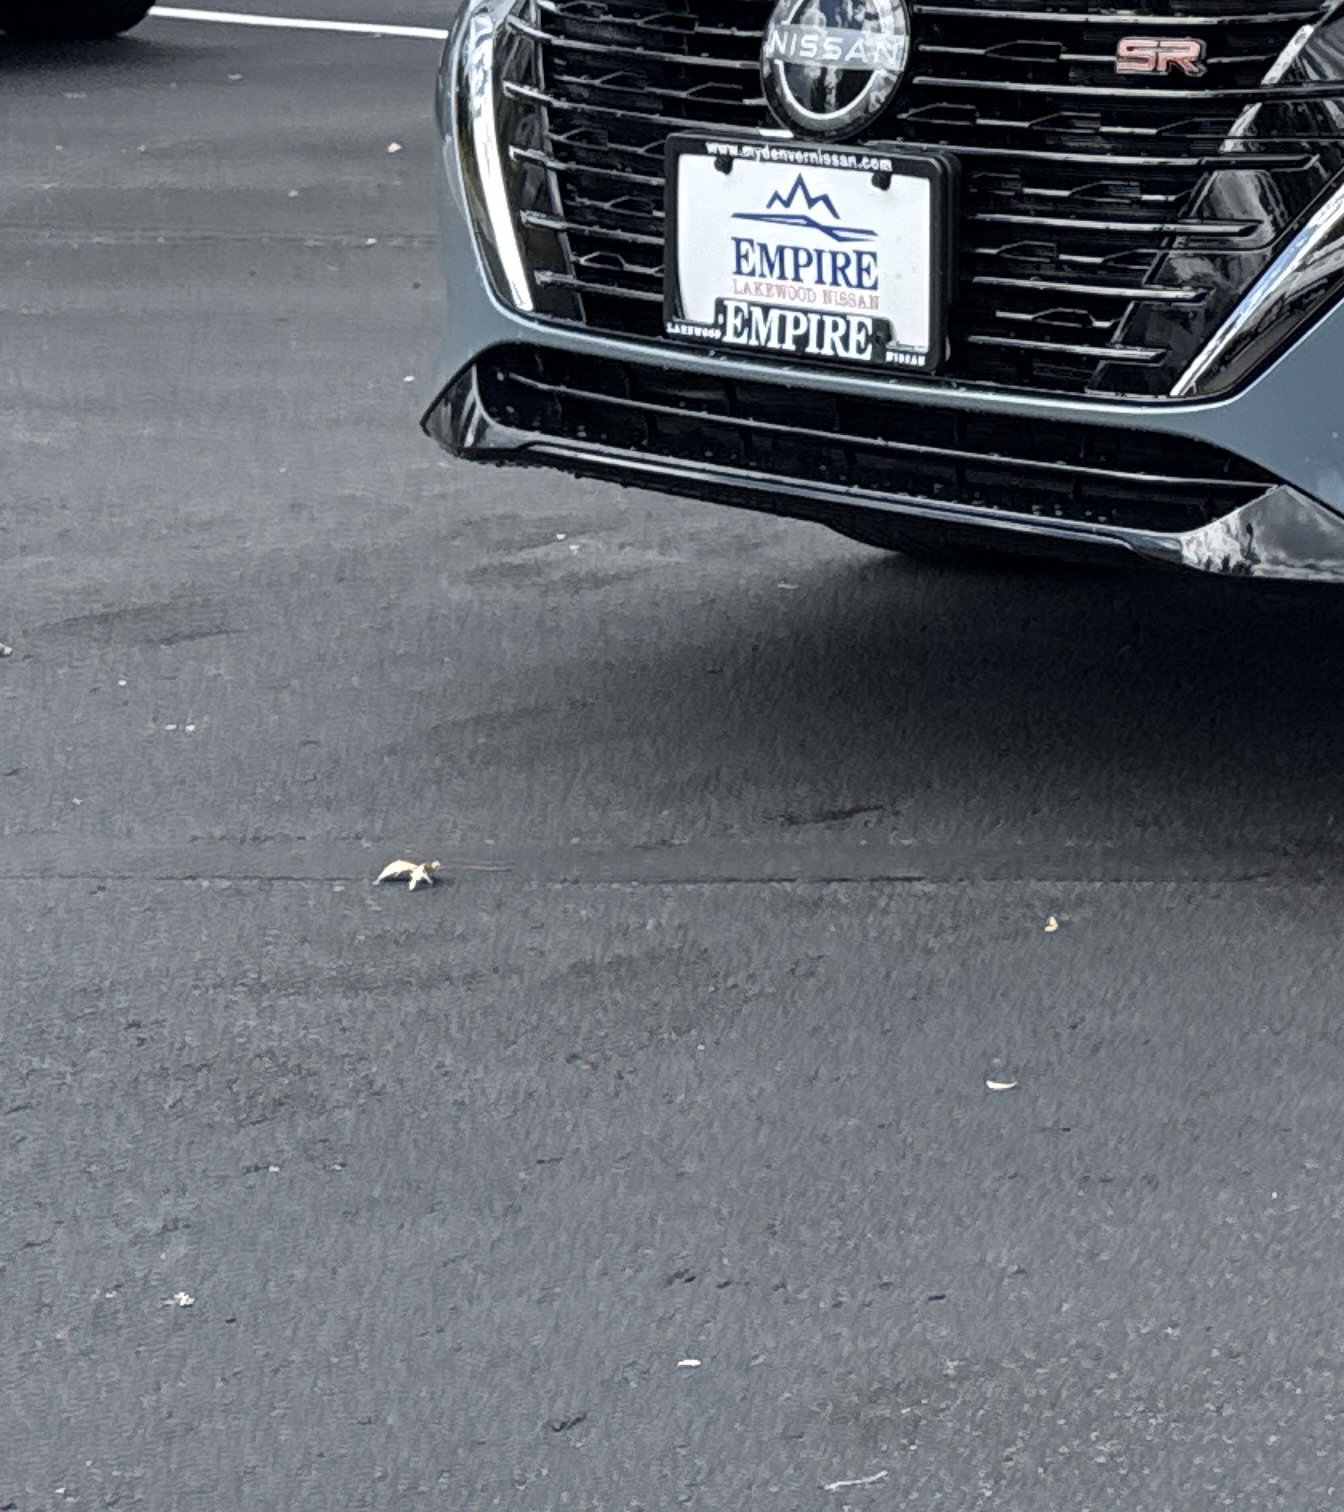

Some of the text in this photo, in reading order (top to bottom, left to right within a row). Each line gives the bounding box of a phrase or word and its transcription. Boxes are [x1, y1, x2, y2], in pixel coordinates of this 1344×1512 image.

[768, 31, 902, 66] NISSAN
[1117, 38, 1206, 75] SR
[731, 237, 879, 291] EMPIRE
[732, 279, 881, 311] LAKEWOOD NISSAN
[722, 299, 873, 362] EMPIRE
